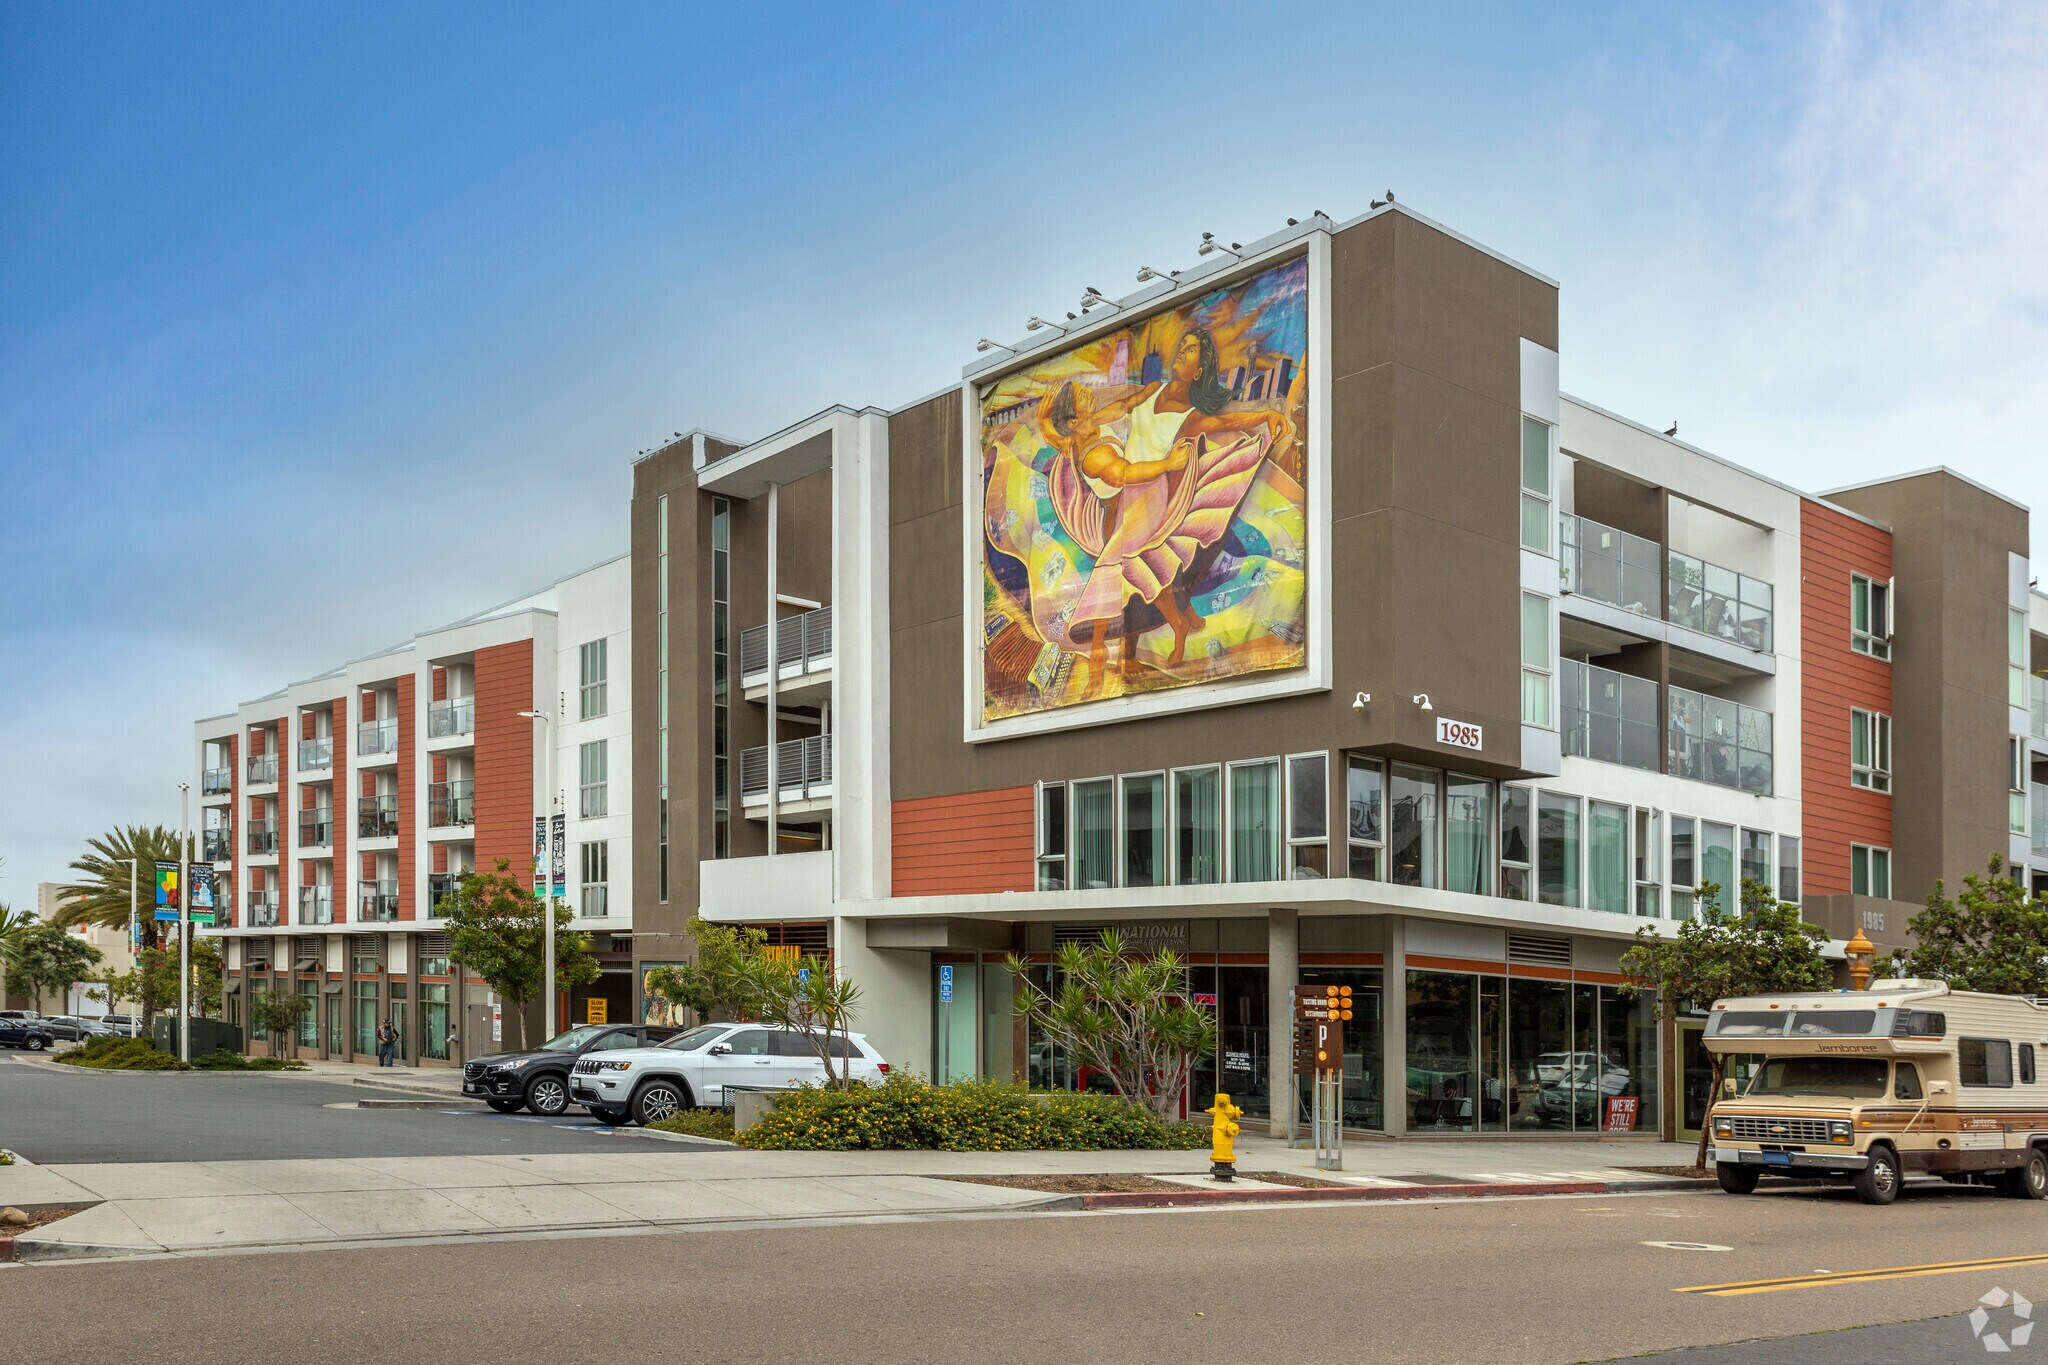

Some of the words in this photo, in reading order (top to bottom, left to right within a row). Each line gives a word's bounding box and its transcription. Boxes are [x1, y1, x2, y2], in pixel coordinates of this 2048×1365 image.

[1441, 722, 1480, 747] 1985
[1863, 911, 1884, 932] 1985
[1120, 926, 1186, 940] NATIONAL
[1159, 938, 1187, 946] CLEANING
[1196, 995, 1216, 1004] OPEN
[1319, 1024, 1327, 1049] P
[1815, 1044, 1878, 1053] Jamboree
[1611, 1099, 1635, 1112] WE'RE
[1610, 1113, 1630, 1126] STILL
